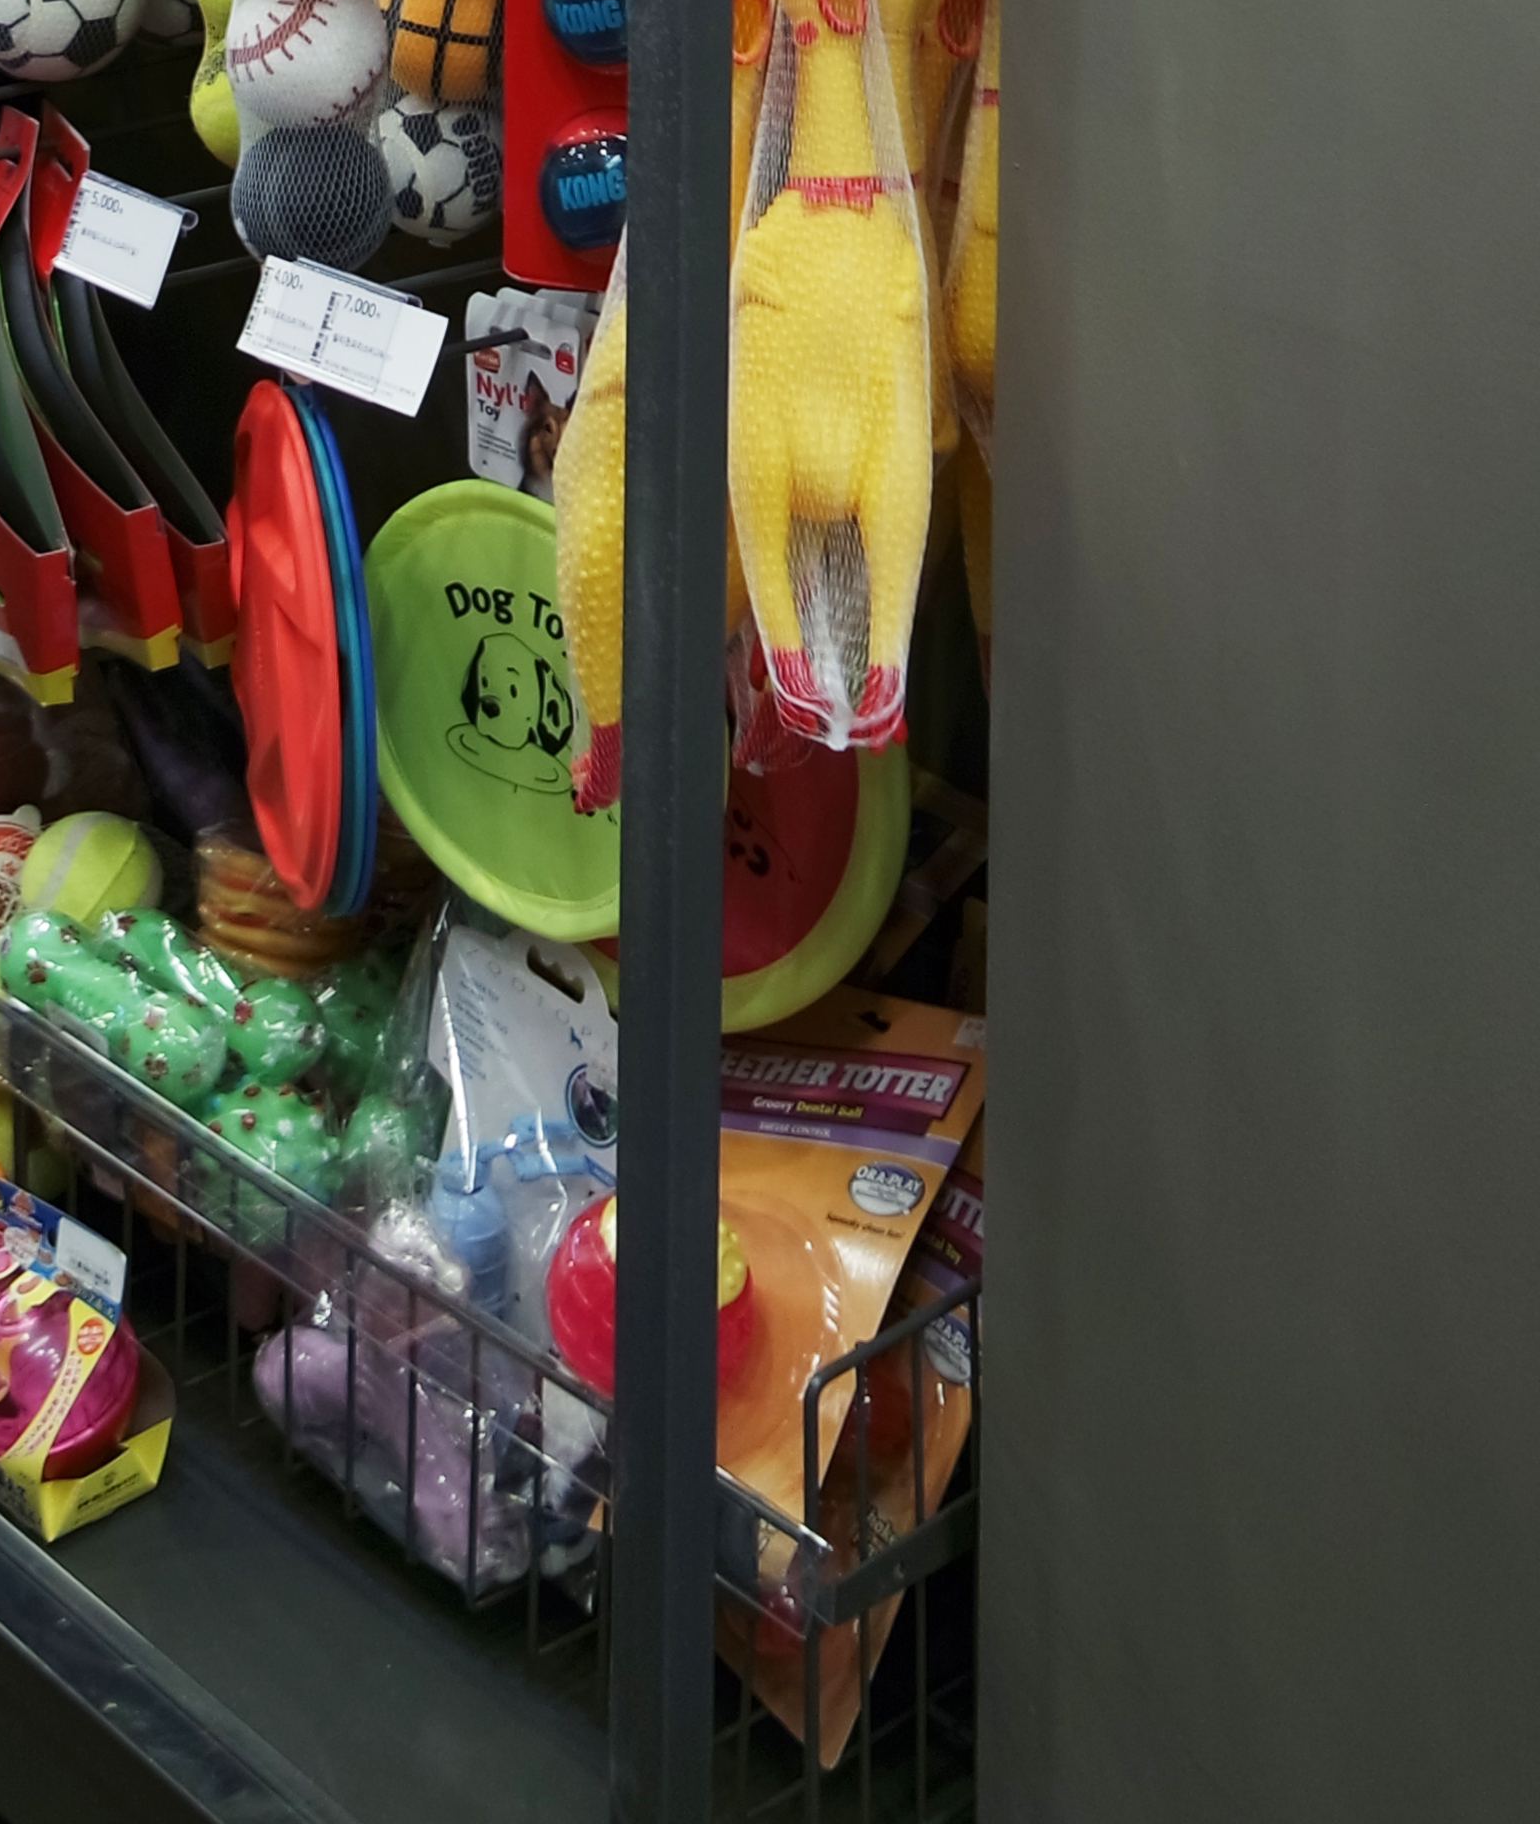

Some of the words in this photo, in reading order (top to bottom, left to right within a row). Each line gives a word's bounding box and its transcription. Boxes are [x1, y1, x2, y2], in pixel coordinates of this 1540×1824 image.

[558, 167, 627, 211] KONG
[477, 398, 501, 421] Toy
[444, 581, 515, 625] Dog
[527, 591, 565, 641] To
[721, 1053, 837, 1089] EETHER
[837, 1062, 953, 1104] TOTTER
[753, 1095, 795, 1114] Groovy
[796, 1100, 837, 1115] Dental
[837, 1105, 864, 1119] Ball
[855, 1165, 923, 1192] ORA-PLAY
